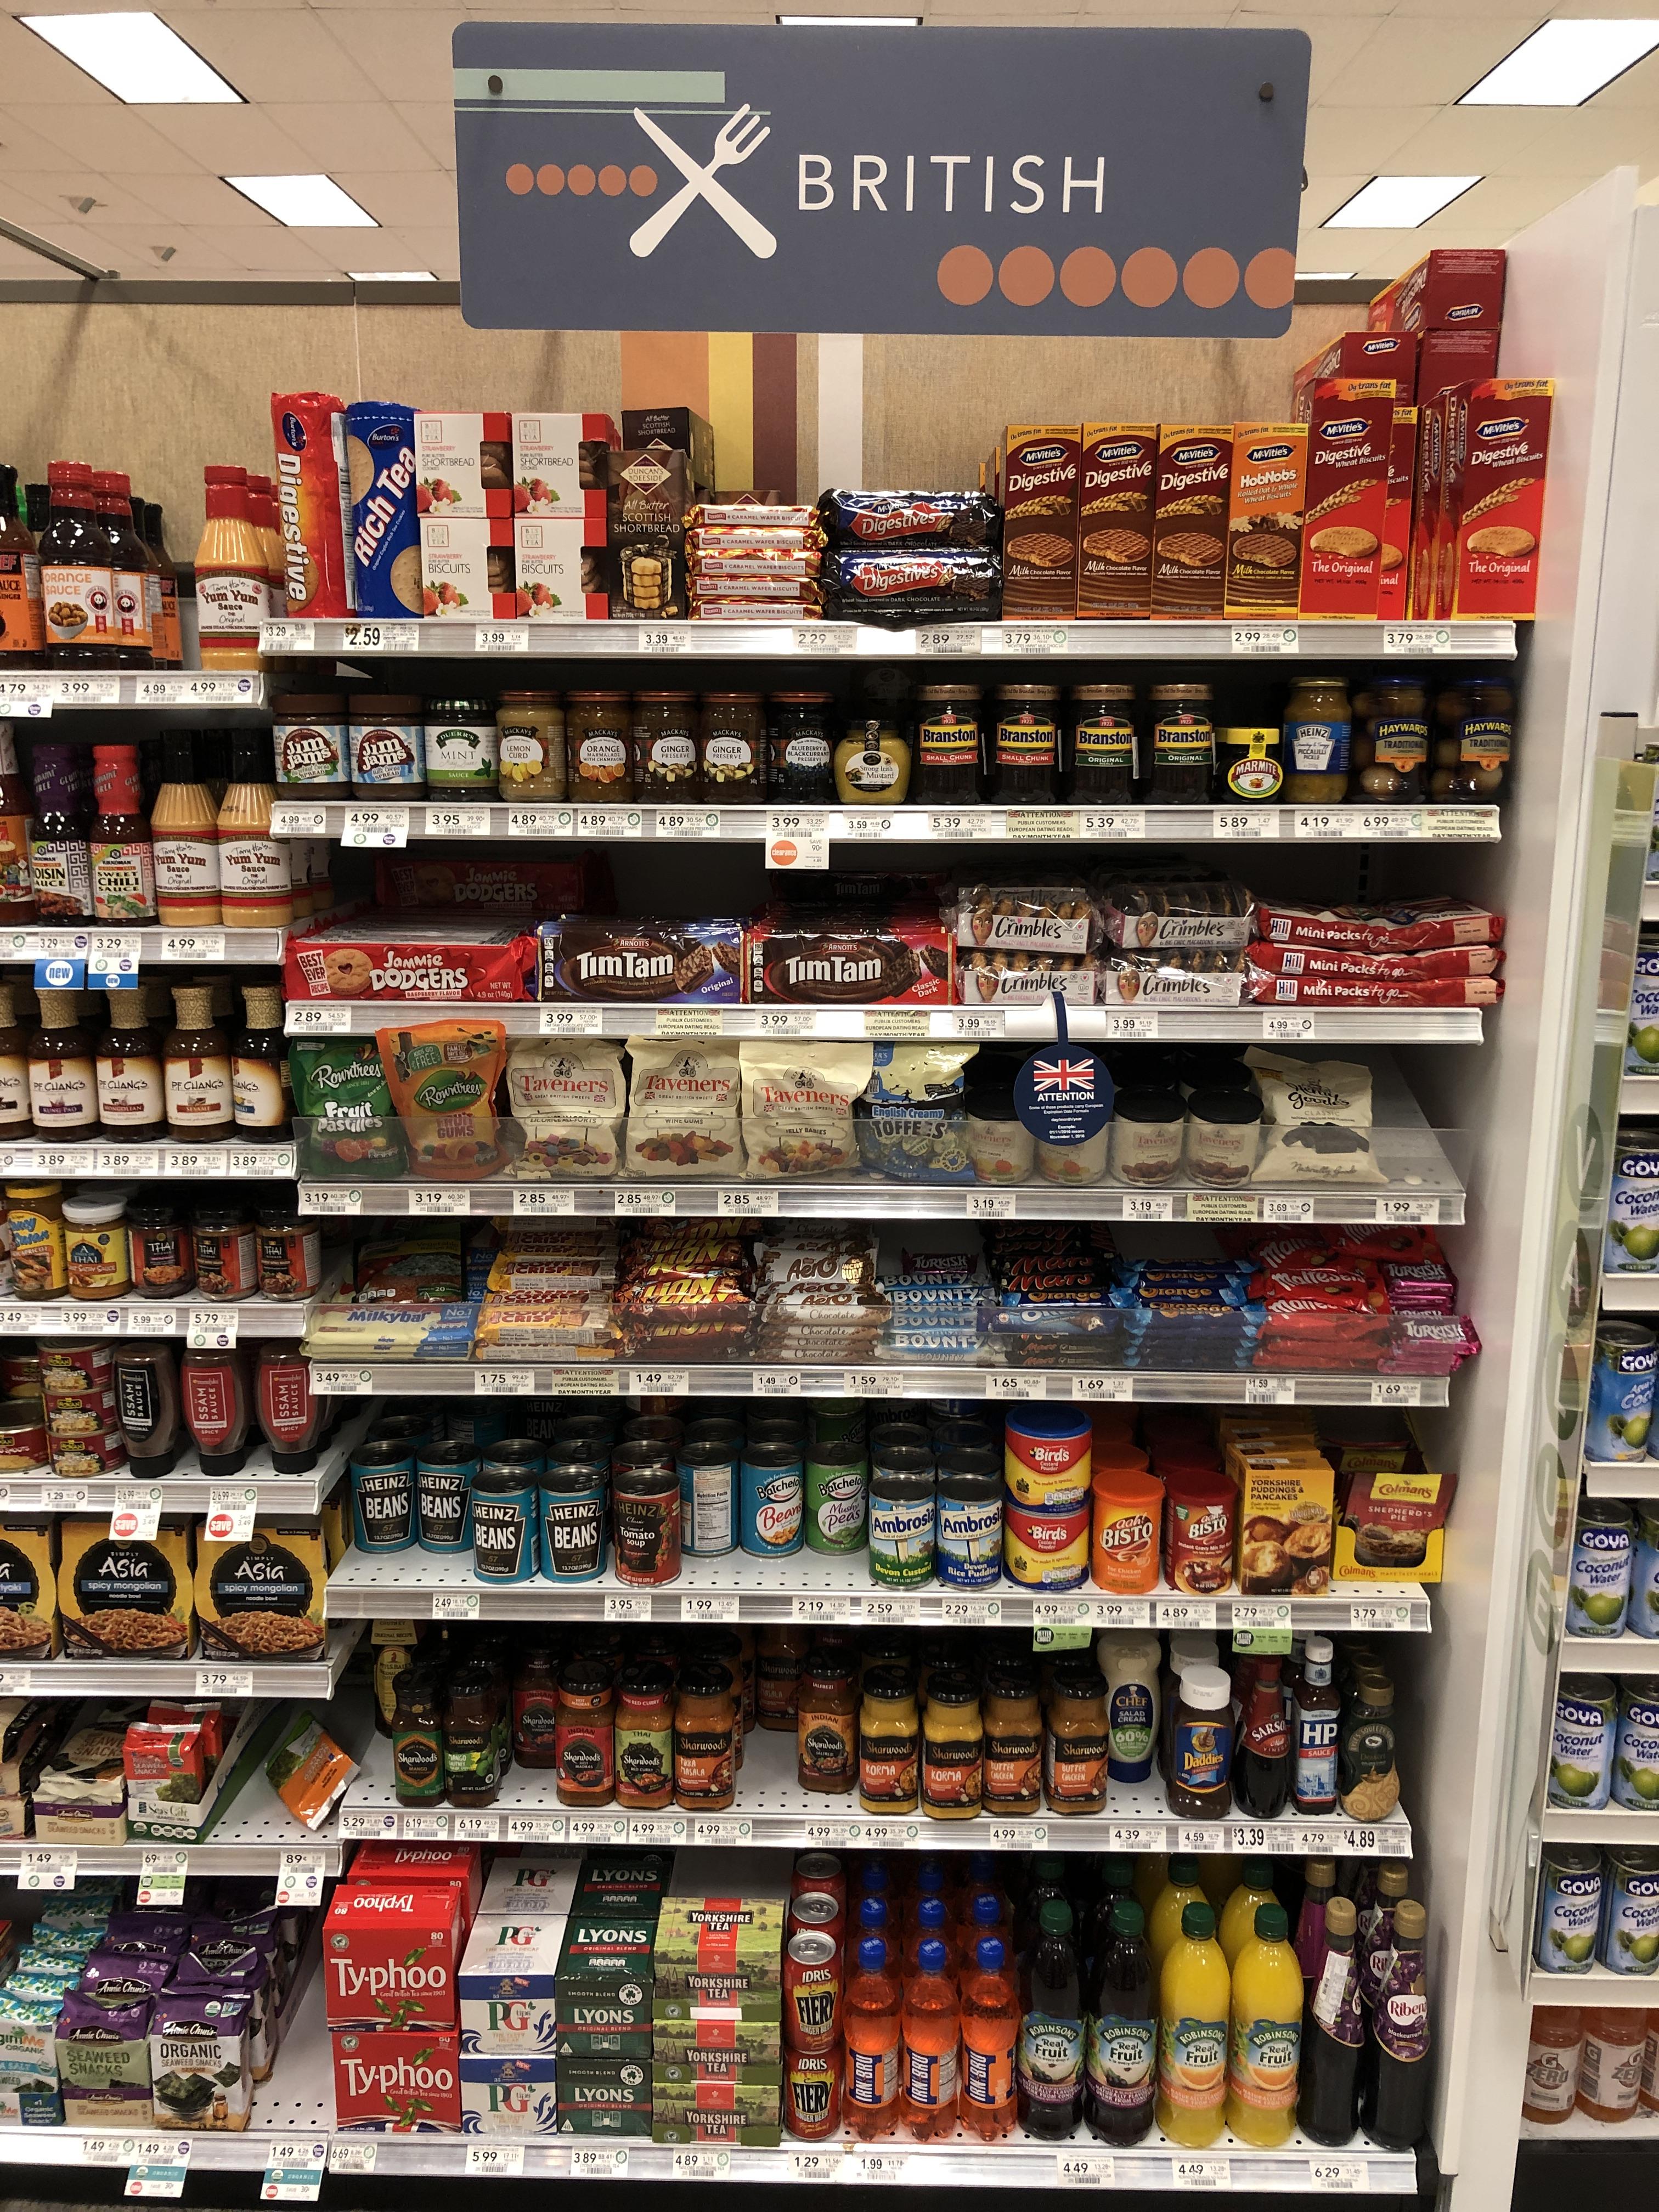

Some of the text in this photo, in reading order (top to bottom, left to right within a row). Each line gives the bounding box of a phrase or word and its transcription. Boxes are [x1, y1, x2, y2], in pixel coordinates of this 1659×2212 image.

[798, 154, 1104, 213] BRITISH
[1368, 339, 1398, 353] McVitie's
[1329, 420, 1369, 436] McVitie's
[372, 432, 399, 443] Burton's
[1025, 448, 1062, 462] McVitie's
[1252, 447, 1288, 461] McVitie's
[1314, 443, 1372, 465] Digestive
[1335, 453, 1386, 469] Wheat Biscuits
[421, 457, 475, 467] SHORTBREAD
[1009, 464, 1076, 492] Digestive
[1160, 463, 1228, 490] Digestive
[1240, 469, 1297, 488] HobNobs
[354, 447, 416, 567] Rich Tea
[624, 500, 669, 510] All Butter
[622, 512, 672, 523] SCOTTISH
[861, 513, 936, 535] Digestives
[276, 452, 311, 602] Digestive
[613, 522, 680, 533] SHORTBREAD
[427, 563, 471, 574] BISCUITS
[1311, 560, 1373, 577] The Original
[44, 573, 93, 584] ORANGE
[46, 585, 81, 596] SAUCE
[202, 590, 258, 606] Yum Yum
[218, 603, 243, 611] Sauce
[440, 730, 475, 741] DUERR'S
[922, 729, 977, 743] Branston
[999, 728, 1054, 743] Branston
[1299, 727, 1328, 738] HEINZ
[441, 750, 477, 760] MINT
[1236, 761, 1278, 775] MARMITE
[866, 771, 895, 780] Mustard
[772, 848, 797, 858] clearance
[98, 876, 139, 887] CHILI
[453, 883, 538, 903] DODGERS
[995, 916, 1062, 940] Crimble's
[1271, 919, 1289, 935] Hill
[1295, 926, 1361, 941] Mini Packs
[300, 953, 322, 968] BEST
[383, 951, 443, 968] Jammie
[577, 952, 674, 980] TimTam
[48, 966, 71, 980] new
[306, 967, 326, 981] EVER
[785, 956, 881, 984] TimTam
[369, 968, 468, 991] DODGERS
[701, 977, 734, 994] Original
[911, 978, 941, 993] Classic
[311, 984, 330, 995] RECIPE
[917, 986, 939, 998] Dark
[520, 1075, 608, 1093] Taveners
[645, 1075, 731, 1092] Taveners
[1037, 1091, 1094, 1102] ATTENTION
[324, 1102, 373, 1118] Fruit
[873, 1106, 944, 1120] English Creamy
[317, 1116, 383, 1132] Pastilles
[437, 1126, 475, 1138] GUMS
[346, 1310, 431, 1323] Milkybar
[502, 1313, 555, 1323] CRISP
[1406, 1321, 1465, 1341] TURKISH
[894, 1334, 986, 1349] BOUNTY
[125, 1382, 136, 1418] SSÄM
[1035, 1447, 1070, 1463] Bird's
[364, 1475, 406, 1491] HEINZ
[1378, 1482, 1433, 1499] Colman's
[365, 1495, 409, 1520] BEANS
[1368, 1505, 1433, 1517] SHEPHERD'S
[759, 1504, 802, 1531] Beans
[824, 1509, 861, 1533] Peas
[210, 1519, 232, 1533] save
[620, 1526, 655, 1539] Tomato
[1102, 1521, 1153, 1548] BISTO
[1582, 1532, 1629, 1550] GOYA
[626, 1537, 646, 1549] soup
[234, 1560, 285, 1582] Asia
[902, 1562, 932, 1576] Custard
[1590, 1571, 1622, 1584] Water
[224, 1582, 298, 1594] spicy mongolian
[1115, 1696, 1148, 1707] CHEF
[1115, 1730, 1149, 1743] 60%
[1302, 1722, 1338, 1746] HP
[398, 1752, 438, 1765] Sharwood's
[1307, 1749, 1331, 1758] SAUCE
[1184, 1752, 1223, 1771] Daddies
[866, 1763, 896, 1776] KORMA
[691, 1912, 751, 1922] YORKSHIRE
[578, 1928, 647, 1943] LYONS
[802, 1970, 832, 1982] IDRIS
[1178, 2030, 1225, 2045] ROBINSONS
[1387, 2028, 1423, 2039] blackcurrant
[160, 2043, 222, 2060] ORGANIC
[1194, 2043, 1215, 2053] Real
[1186, 2050, 1218, 2064] Fruit
[794, 2080, 833, 2113] FIERY
